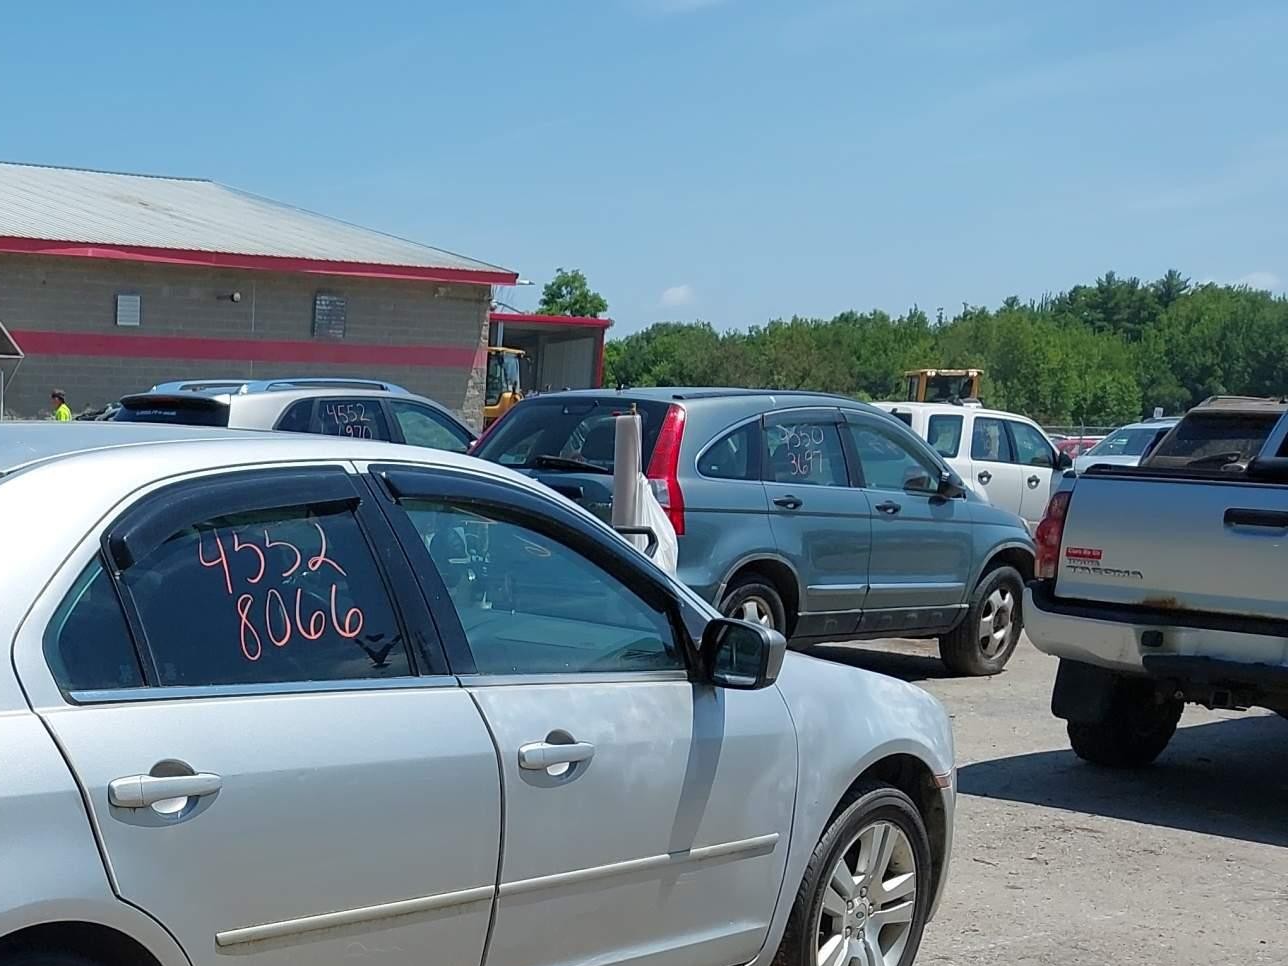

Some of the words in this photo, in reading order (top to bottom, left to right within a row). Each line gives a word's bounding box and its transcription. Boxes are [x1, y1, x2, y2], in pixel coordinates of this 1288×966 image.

[326, 403, 371, 424] 4552
[787, 450, 822, 475] 3697
[198, 522, 348, 594] 4552
[237, 584, 364, 661] 8066
